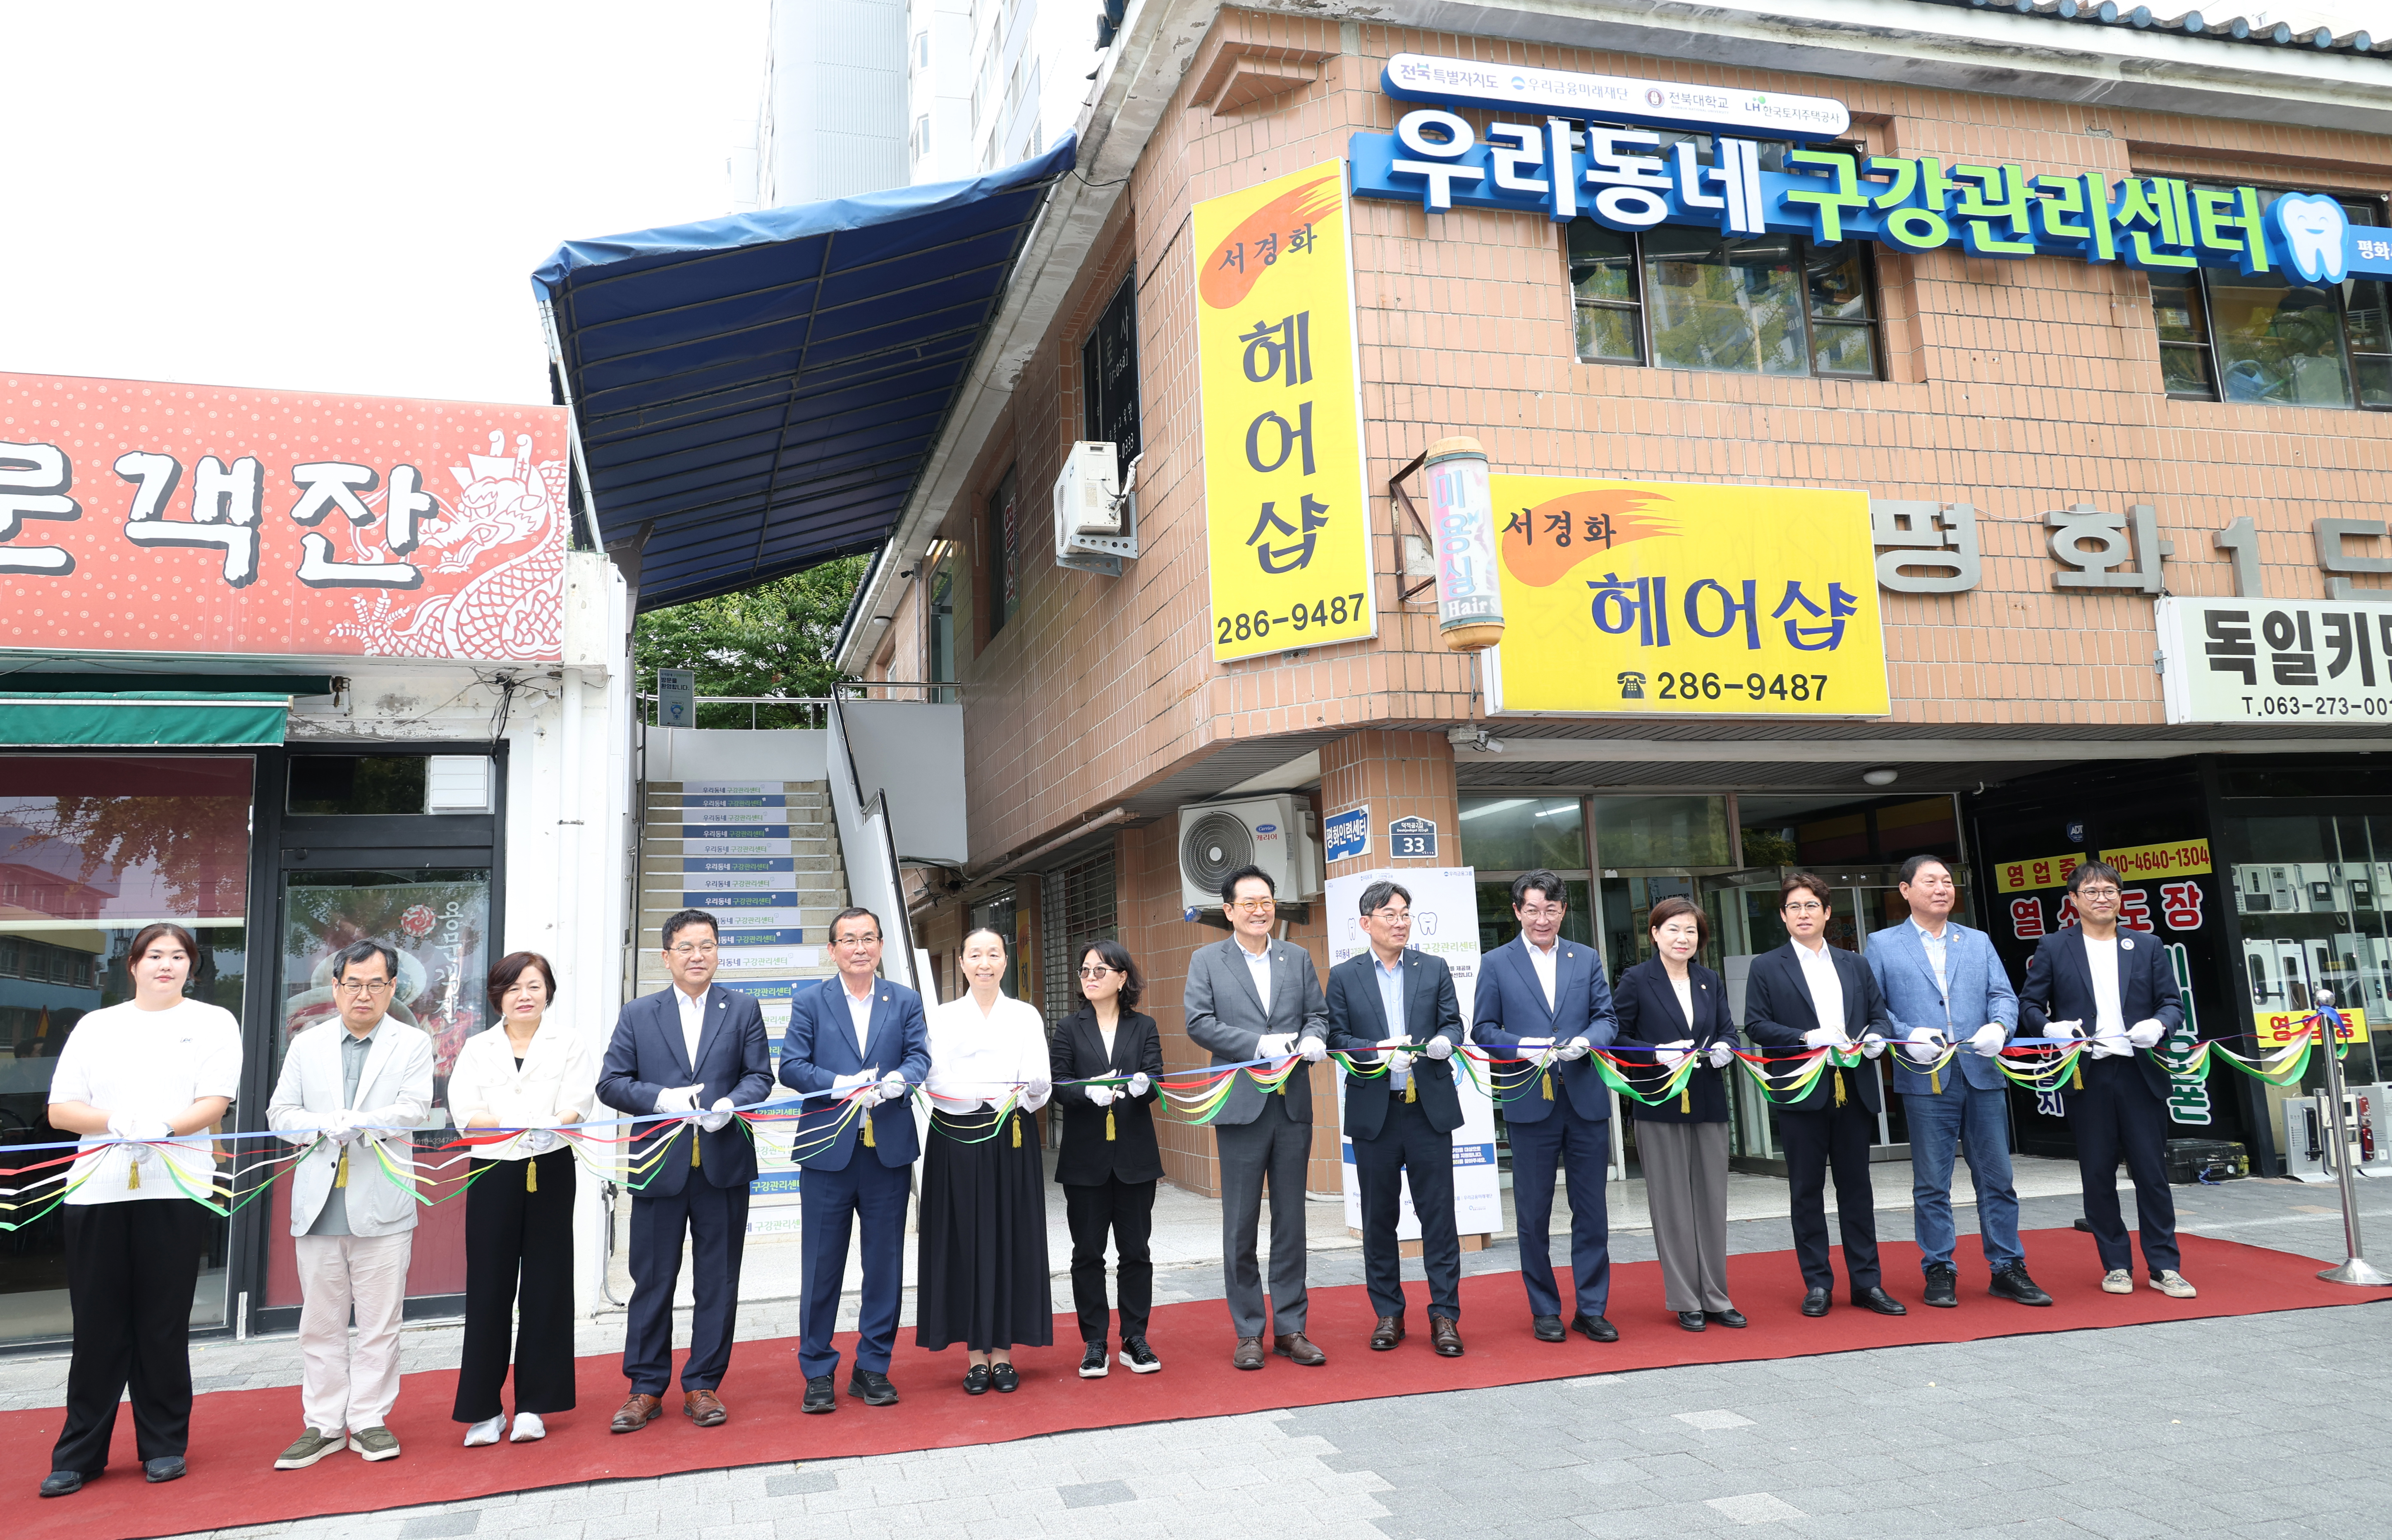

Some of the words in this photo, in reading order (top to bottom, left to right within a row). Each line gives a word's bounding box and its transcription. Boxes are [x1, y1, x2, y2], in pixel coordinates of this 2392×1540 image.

[1401, 63, 1499, 88] 전북특별자치도
[1528, 79, 1629, 101] 우리금융미래재단
[1670, 92, 1729, 108] 전북대학교
[1745, 102, 1760, 112] LH
[1763, 105, 1840, 124] 한국토지주택공사
[1391, 108, 1765, 234] 우리동네
[1787, 150, 2270, 272] 구강관리센터
[1218, 222, 1318, 275] 서경화
[2357, 239, 2392, 261] 평화
[1238, 309, 1330, 574] 헤어샵
[1434, 469, 1476, 598] 미용실
[1502, 507, 1617, 549] 서경화
[1218, 592, 1365, 645] 286-9487
[1447, 597, 1488, 619] Hair
[1586, 572, 1859, 652] 헤어샵
[1658, 672, 1828, 702] 286-9487
[1256, 833, 1277, 842] 캐리어
[1326, 817, 1366, 849] 평화인력센터
[2070, 825, 2083, 835] ADT
[1403, 837, 1425, 852] 33
[2105, 846, 2210, 873] 010-4640-1304
[1335, 949, 1350, 960] 우리동네
[1422, 941, 1477, 953] 구강관리센터
[719, 958, 741, 966] 리동네
[743, 957, 787, 966] 구강관리센터
[745, 987, 792, 997] 구강관리센터
[755, 1219, 800, 1232] 구강관리센
